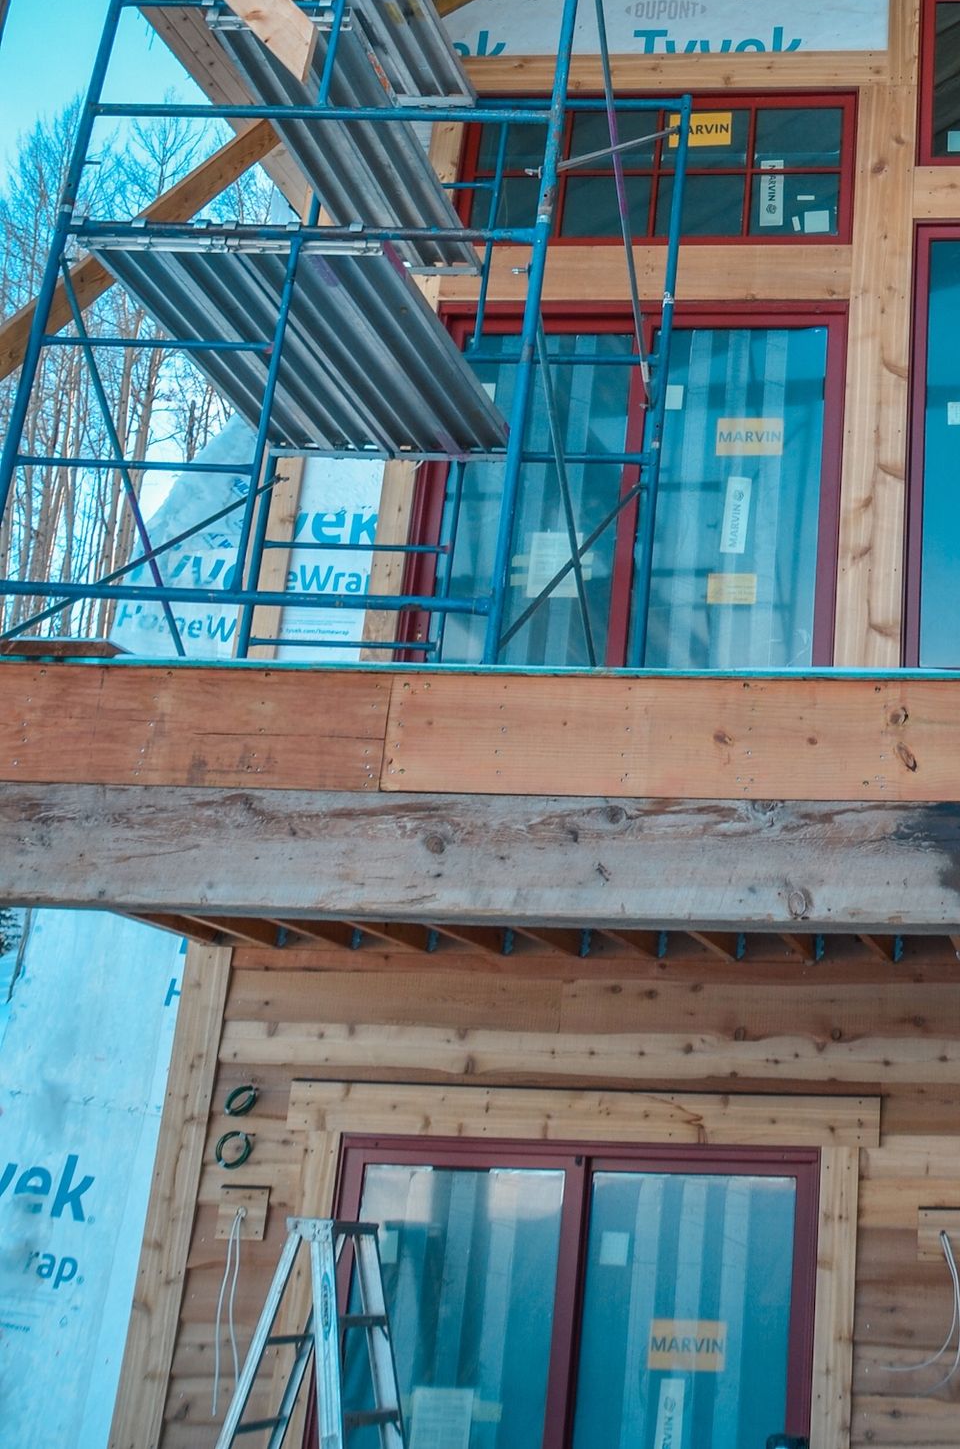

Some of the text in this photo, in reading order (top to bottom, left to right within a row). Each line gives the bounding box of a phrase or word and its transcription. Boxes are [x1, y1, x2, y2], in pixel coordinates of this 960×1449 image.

[634, 0, 699, 20] DUPONT
[669, 123, 730, 136] ARVIN
[718, 431, 782, 443] MARVIN
[729, 504, 742, 548] MARVIN
[650, 1336, 725, 1354] MARVIN
